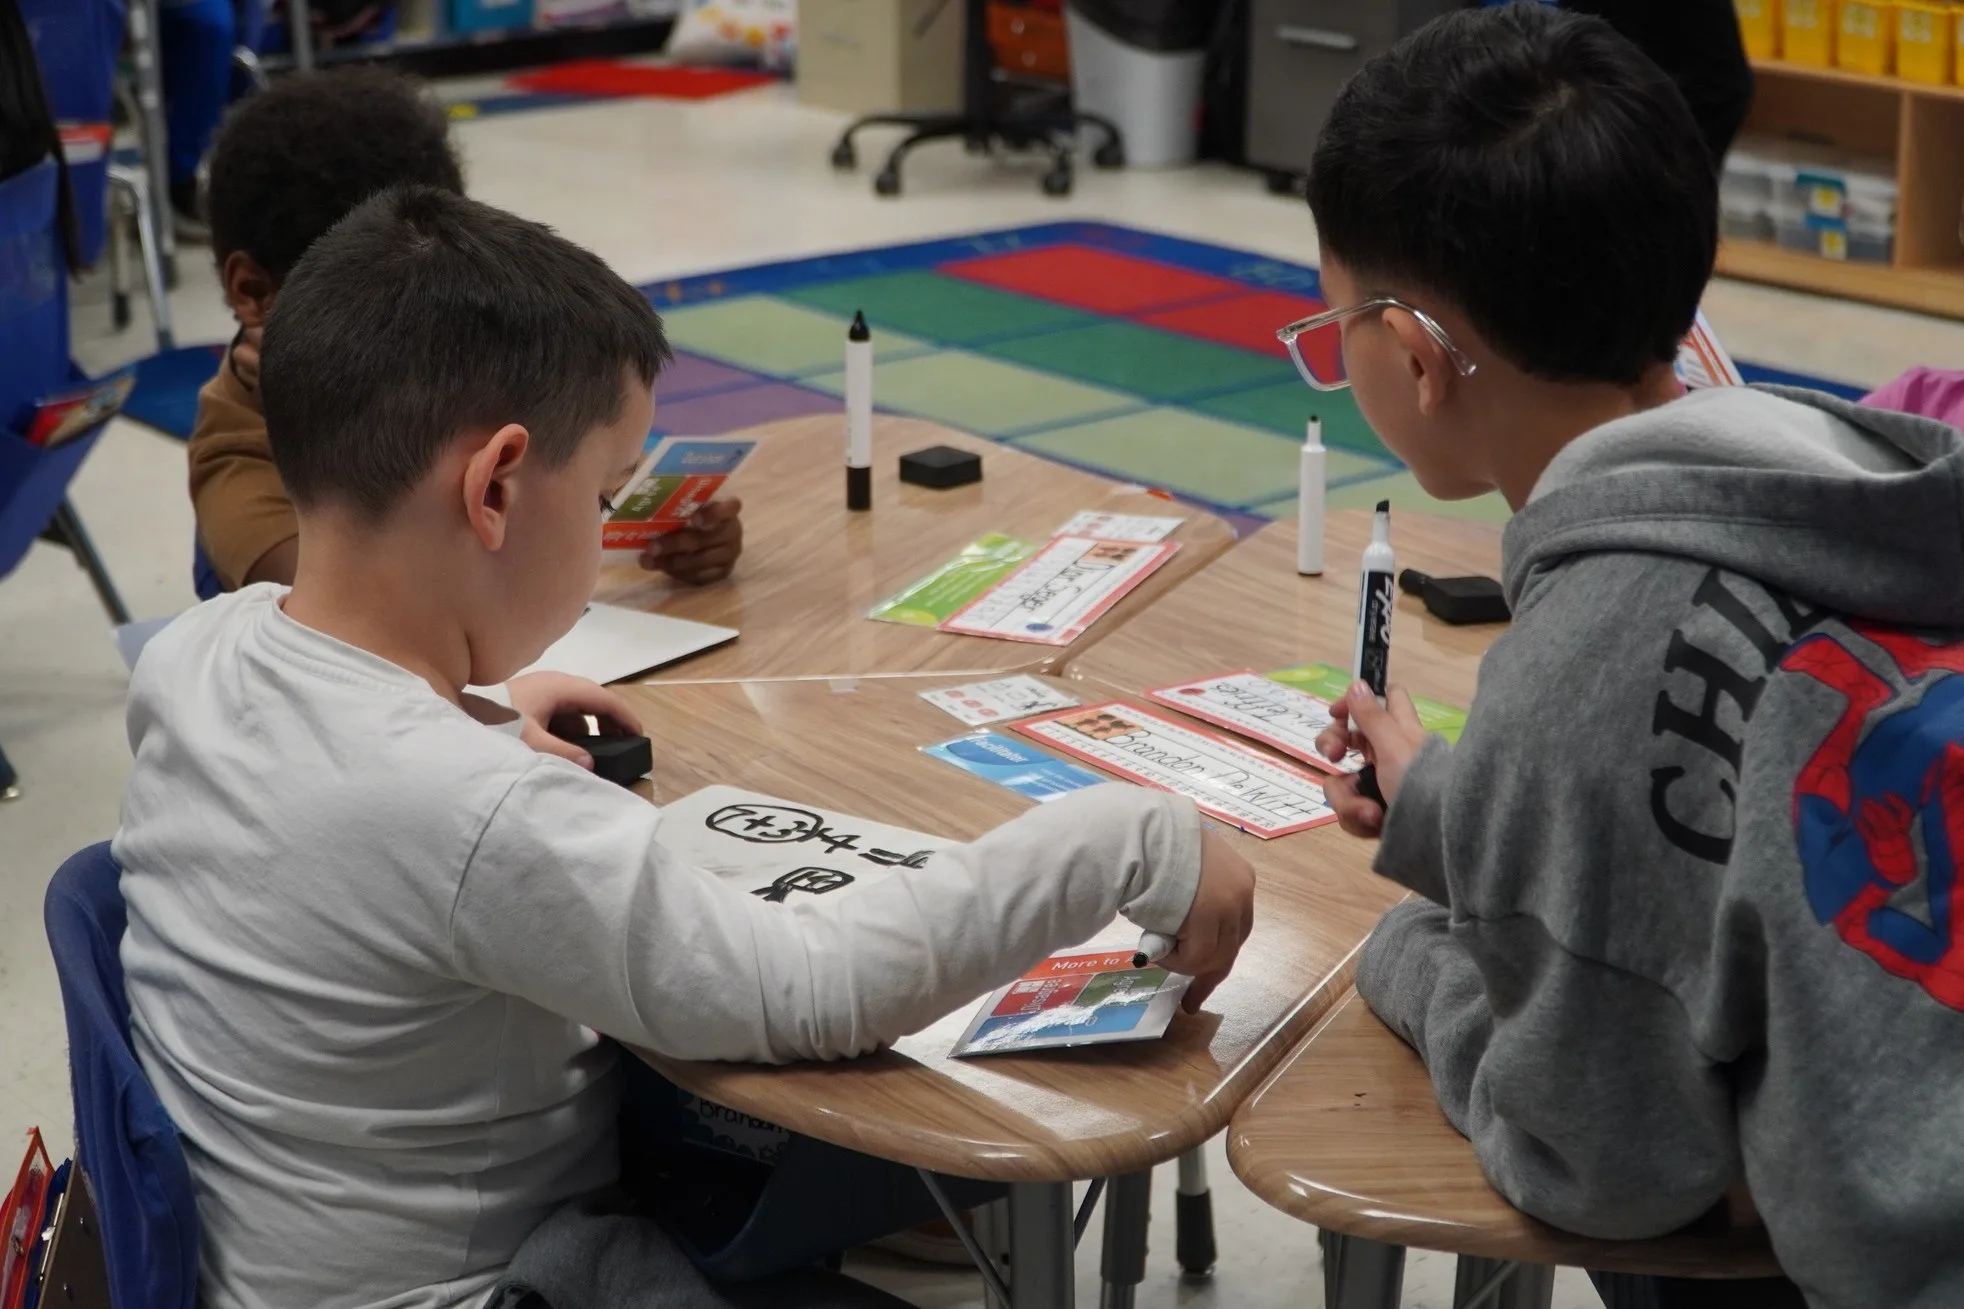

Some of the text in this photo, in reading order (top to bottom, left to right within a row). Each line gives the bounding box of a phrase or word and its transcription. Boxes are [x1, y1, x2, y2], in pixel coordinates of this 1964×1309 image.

[1651, 566, 1832, 866] CHI
[1104, 728, 1205, 774] Brandon
[1051, 958, 1098, 971] More
[1102, 957, 1121, 966] to
